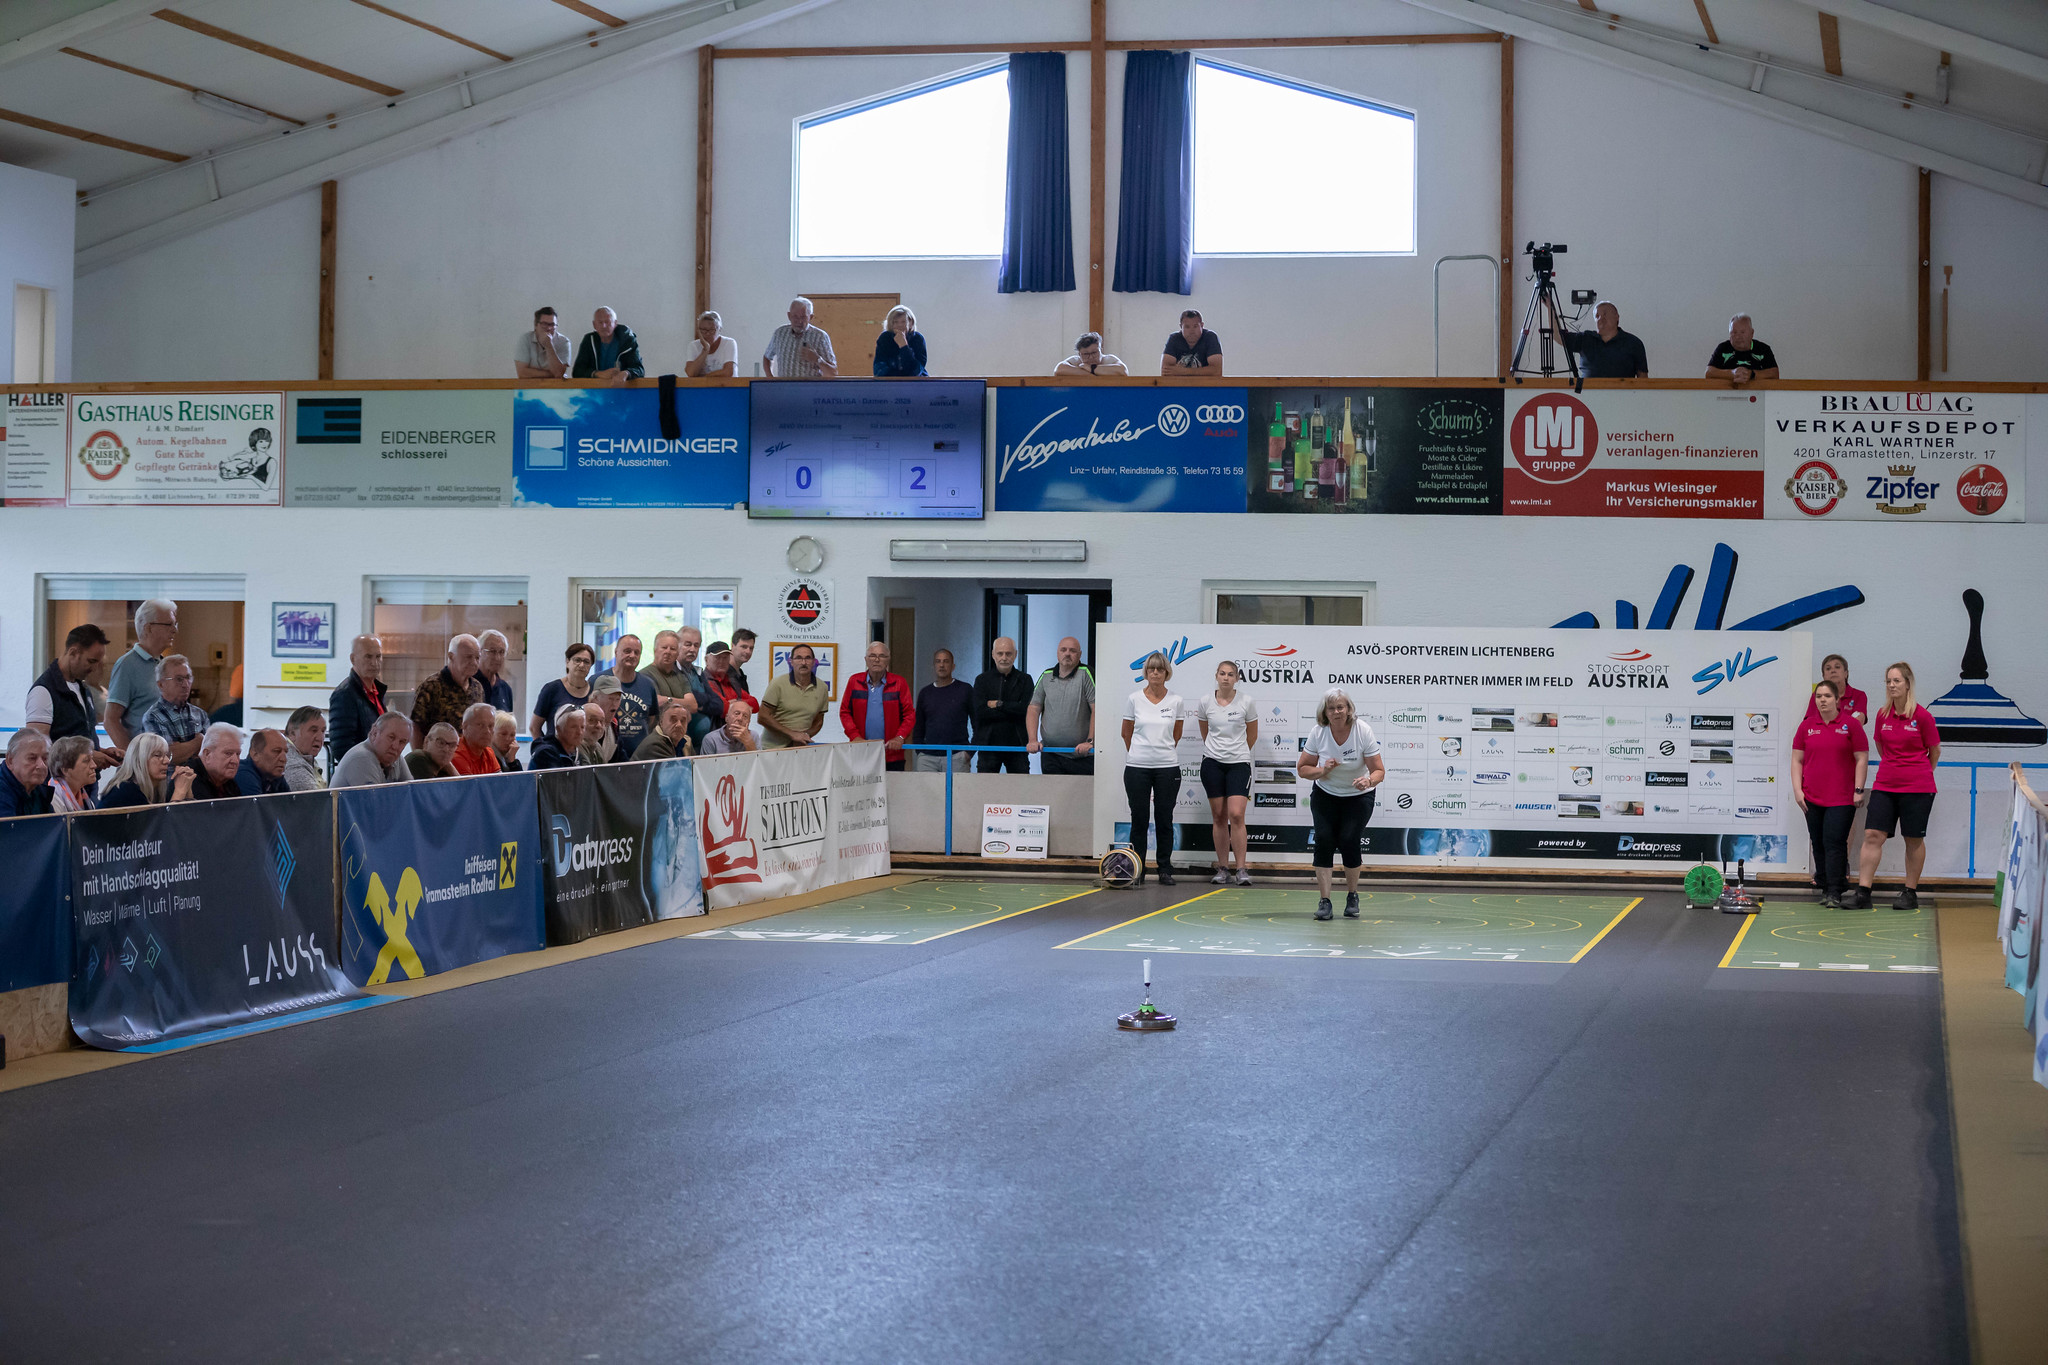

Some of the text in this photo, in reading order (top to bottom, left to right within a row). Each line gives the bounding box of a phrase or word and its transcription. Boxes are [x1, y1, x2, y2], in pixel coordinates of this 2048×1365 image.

[9, 393, 65, 406] HALLER
[1821, 395, 1974, 412] BRAU AG
[78, 400, 274, 422] GASTHAUS REISINGER
[1429, 405, 1482, 431] Schurm's
[1204, 427, 1238, 438] Audi
[1777, 420, 2016, 435] VERKAUFSDEPOT
[136, 437, 227, 447] Autom. Kegelbahnen
[381, 431, 496, 444] EIDENBERGER
[1606, 430, 1674, 442] versichern
[578, 438, 738, 454] SCHMIDINGER
[1834, 437, 1954, 448] KARL WARTNER
[87, 450, 120, 461] KAISER
[155, 450, 205, 459] Gute Küche
[381, 449, 447, 459] schlosserei
[1419, 445, 1455, 453] Fruchtsäfte
[1464, 445, 1487, 454] Sirupe
[1606, 446, 1758, 460] veranlagen-finanzieren
[1793, 448, 1996, 460] 4201 Gramastetten, Linzerstr. 17
[135, 462, 218, 473] Gepflegte Getränke
[578, 457, 671, 467] Schöne Aussichten.
[1532, 460, 1576, 472] gruppe
[1092, 466, 1118, 476] Urfahr,
[1119, 466, 1164, 475] Reindlstraße
[1166, 466, 1179, 476] 35,
[1183, 467, 1209, 475] Telefon
[1211, 467, 1221, 475] 73
[1223, 467, 1231, 475] 15
[1233, 467, 1244, 475] 59
[795, 465, 812, 490] 0
[909, 466, 927, 490] 2
[1417, 481, 1450, 490] Tafeläpfel
[1459, 481, 1488, 490] Erdäpfel
[1606, 482, 1717, 495] Markus Wiesinger
[1796, 481, 1835, 495] KAISER
[1866, 476, 1940, 504] Zipfer
[1960, 481, 2004, 498] Coca-Cola
[1415, 496, 1489, 504] www.schurms.at
[1606, 497, 1757, 509] Ihr Versicherungsmakler
[1347, 643, 1555, 658] ASVÖ-SPORTVEREIN LICHTENBERG
[1235, 659, 1315, 669] STOCKSPORT
[1587, 664, 1670, 674] STOCKSPORT
[1237, 669, 1314, 684] AUSTRIA
[1692, 647, 1778, 695] SVL
[1328, 673, 1573, 687] DANK UNSERER PARTNER IMMER IM FELD
[1587, 673, 1670, 689] AUSTRIA
[1392, 712, 1427, 723] schurm
[1693, 716, 1732, 727] Datapress
[1388, 742, 1424, 751] emporia
[1609, 744, 1644, 755] schurm
[1605, 775, 1642, 783] emporia
[1648, 773, 1686, 784] Datapress
[1257, 794, 1294, 805] Datapress
[1432, 799, 1467, 809] schurm
[986, 807, 1012, 815] ASVÖ
[1267, 833, 1277, 841] by
[552, 814, 633, 879] Datapress
[1538, 839, 1587, 848] powered by
[1617, 835, 1681, 854] Datapress
[82, 840, 163, 866] Dein Installateur
[83, 875, 100, 896] mit
[83, 909, 113, 926] Wasser
[148, 897, 167, 914] Luft
[174, 896, 201, 911] Planung
[243, 932, 326, 986] LAUSS
